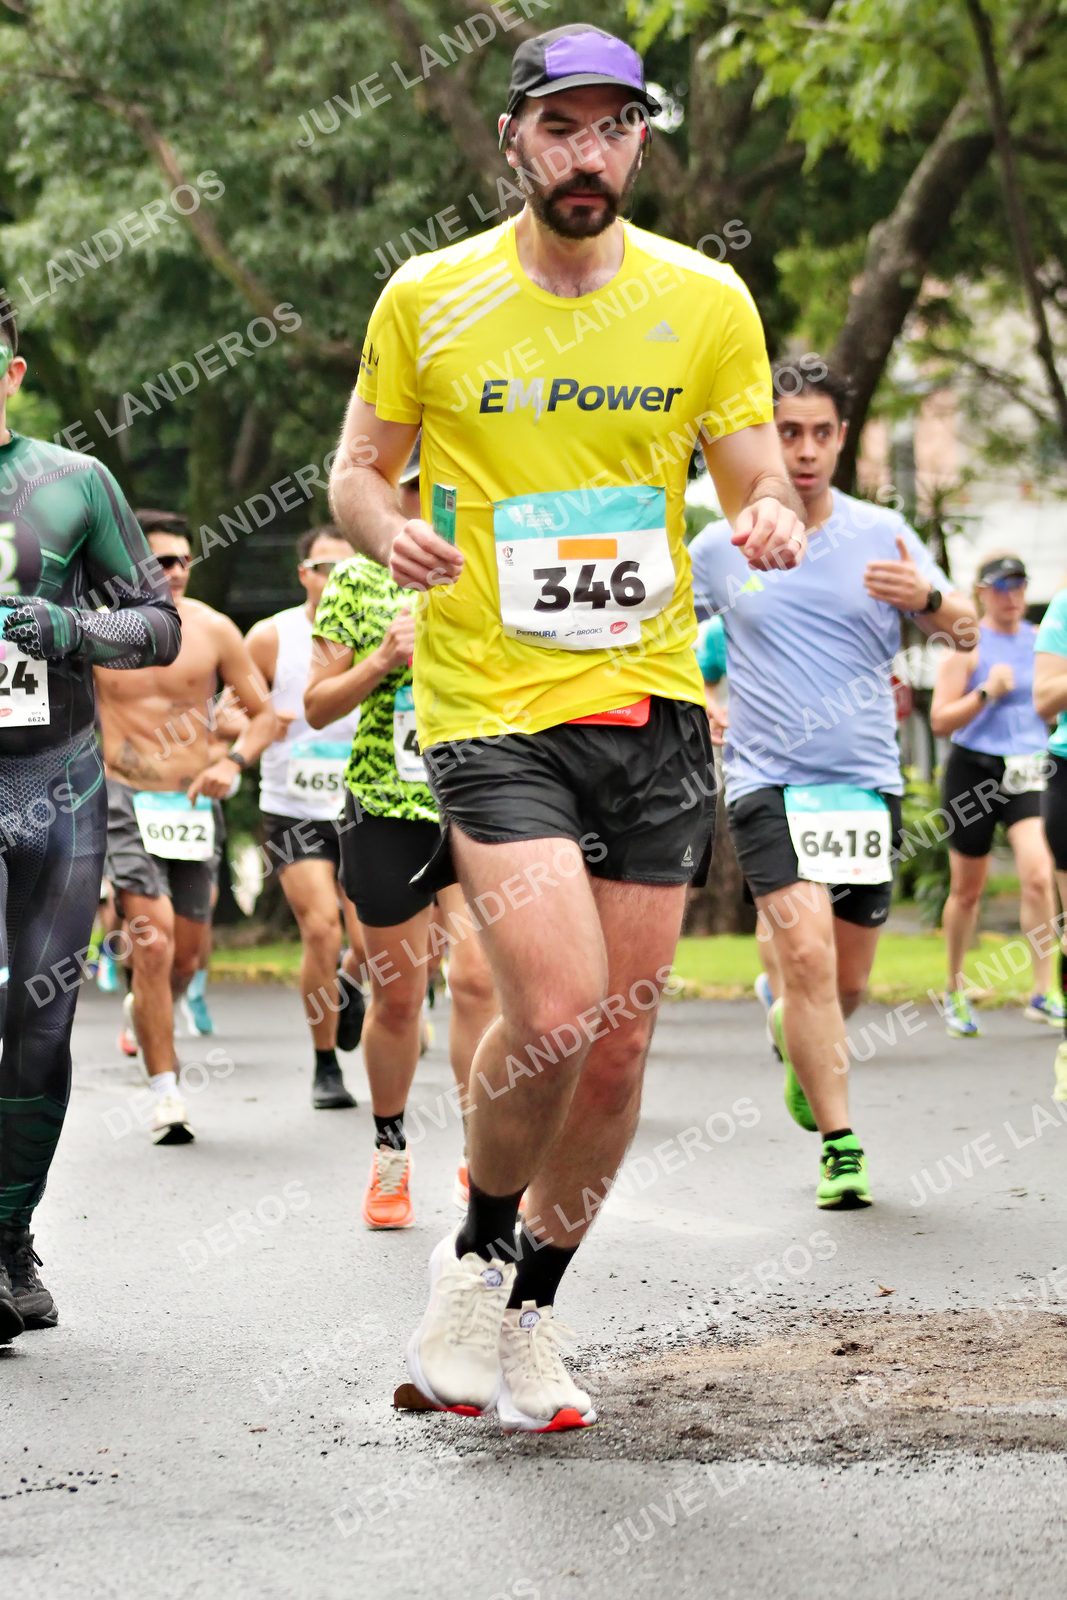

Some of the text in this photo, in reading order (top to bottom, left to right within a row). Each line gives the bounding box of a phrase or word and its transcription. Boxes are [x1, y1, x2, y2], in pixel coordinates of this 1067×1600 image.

[479, 377, 683, 423] EMPower
[533, 560, 646, 613] 346
[576, 628, 603, 637] BROOKS
[403, 730, 421, 756] 4
[295, 771, 346, 791] 465
[147, 823, 206, 841] 6022
[800, 830, 881, 858] 6418
